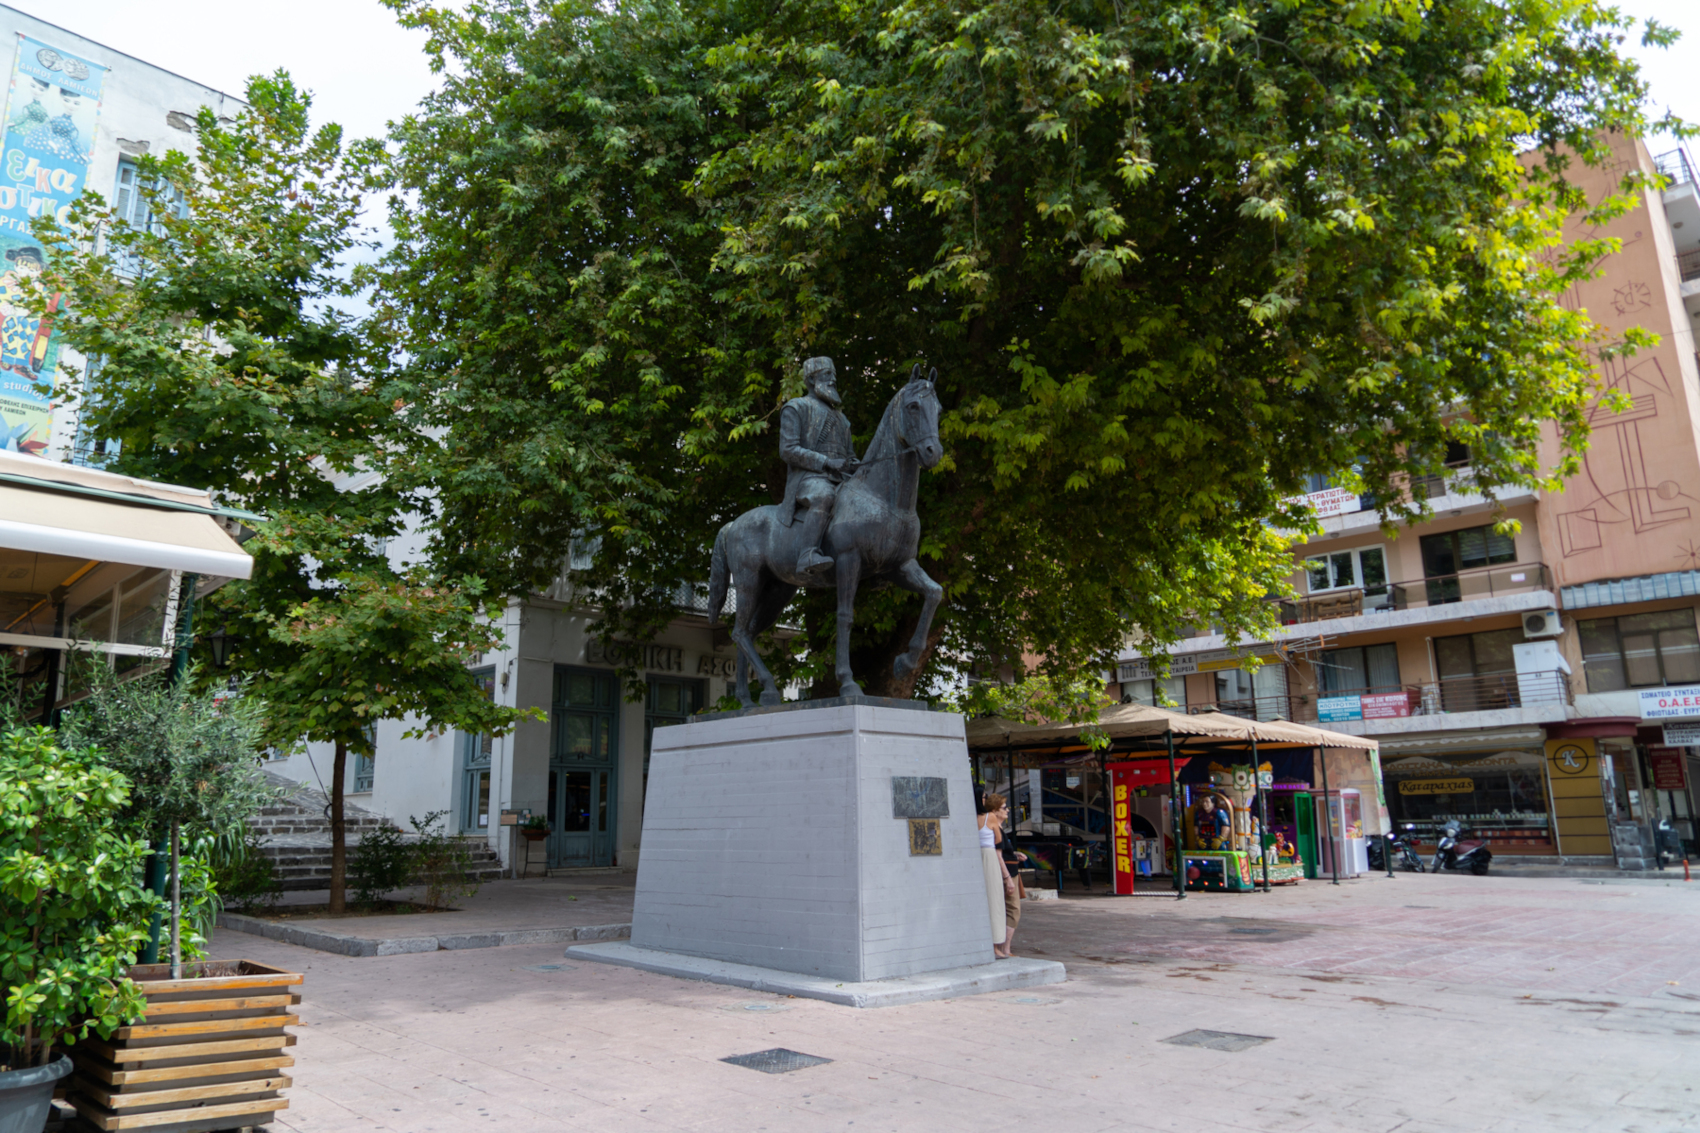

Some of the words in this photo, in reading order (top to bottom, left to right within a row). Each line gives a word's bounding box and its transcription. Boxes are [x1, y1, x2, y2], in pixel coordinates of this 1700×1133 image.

[20, 63, 54, 80] ΔΗΜΟΣ
[58, 77, 98, 97] ΛΑΜΙΕΩΝ
[1641, 691, 1671, 699] ΣΩΜΑΤΕΙΟ
[1646, 709, 1679, 717] ΦΘΙΩΤΙΔΑΣ
[1410, 767, 1460, 778] ΛΑΜΙΑΣ
[1114, 784, 1131, 874] BOXER
